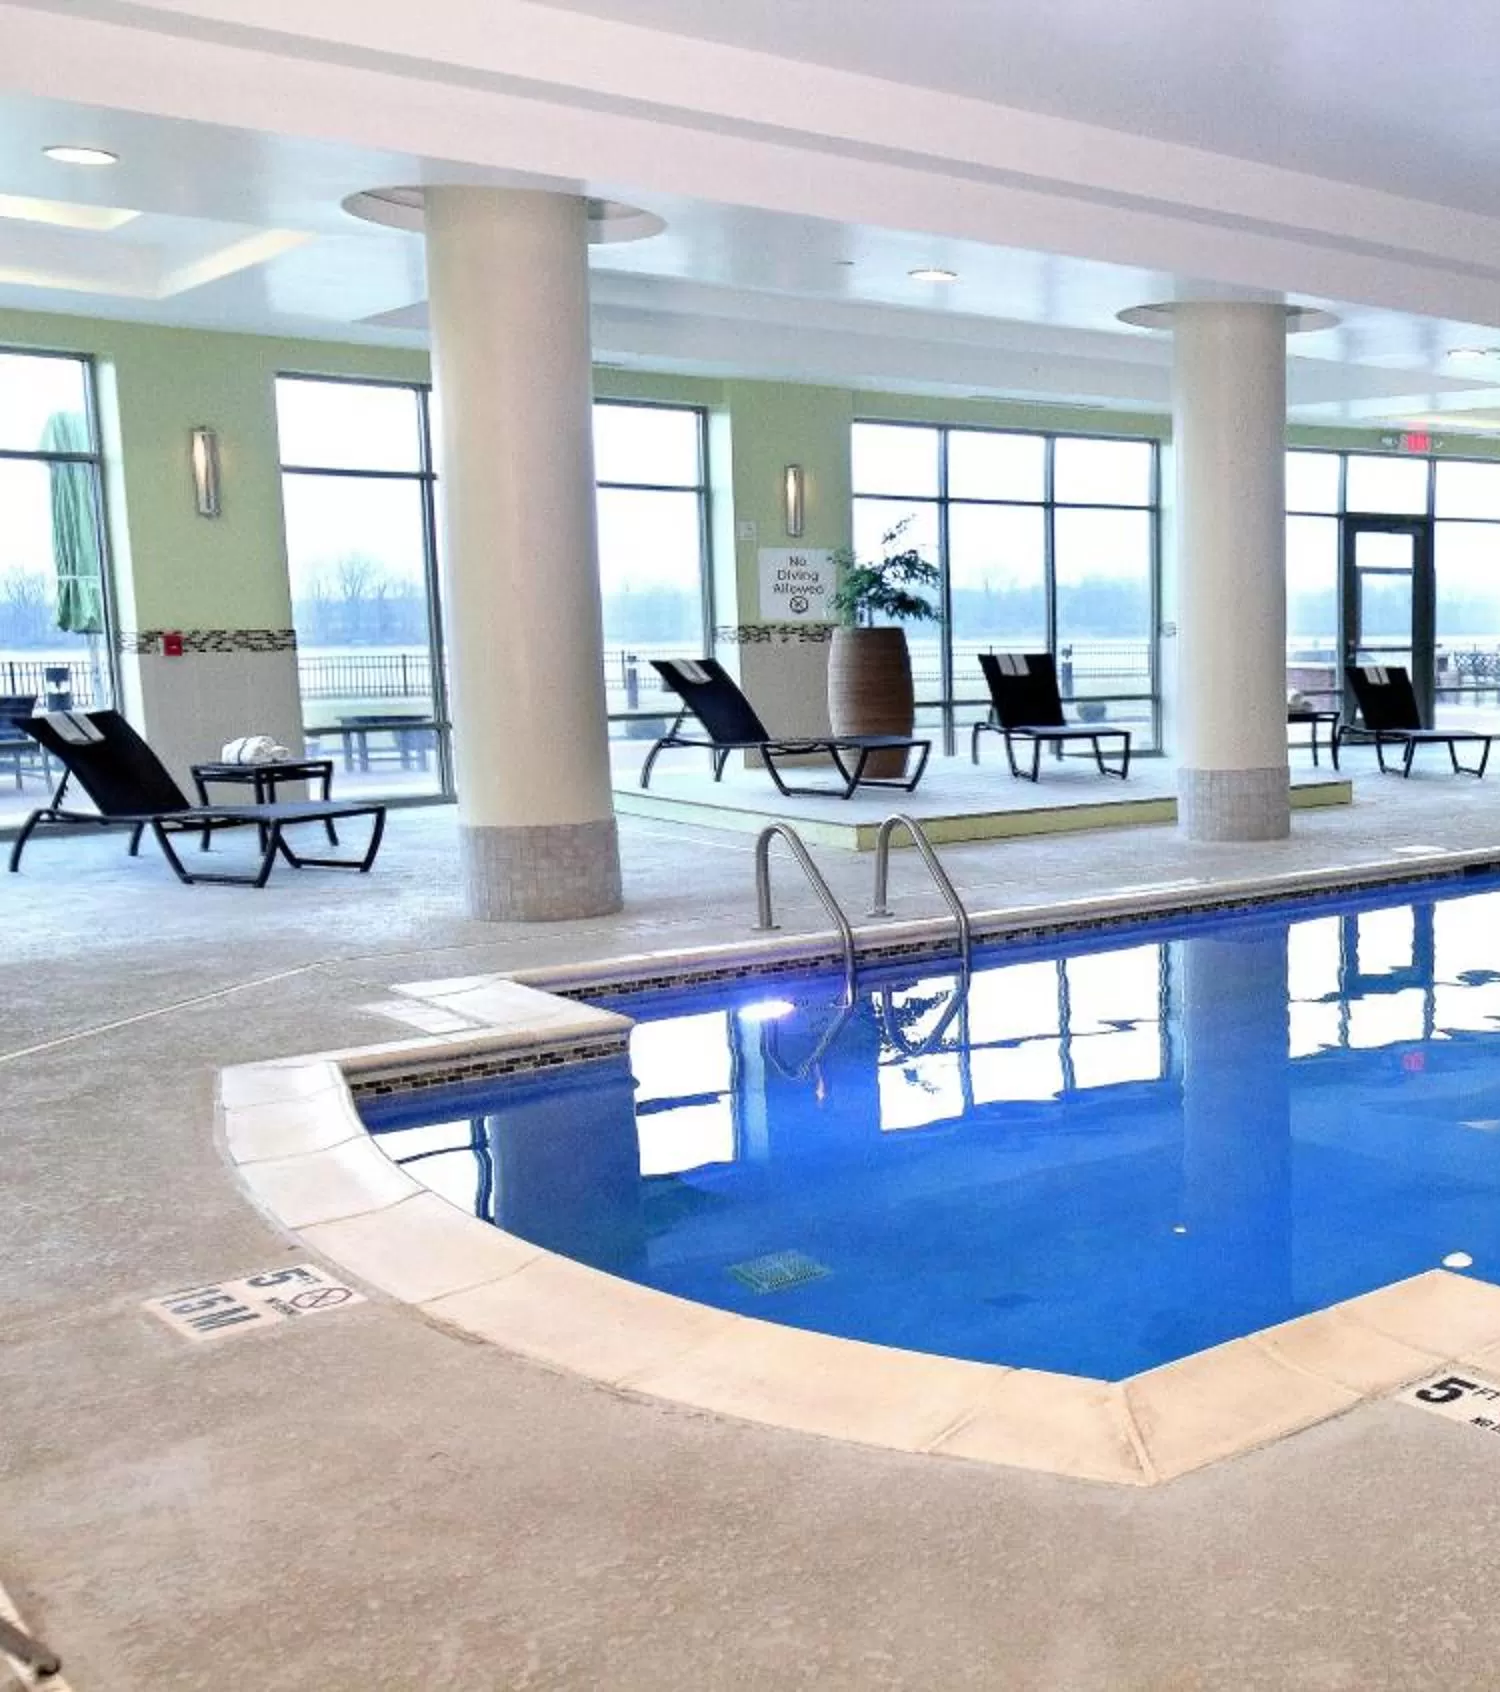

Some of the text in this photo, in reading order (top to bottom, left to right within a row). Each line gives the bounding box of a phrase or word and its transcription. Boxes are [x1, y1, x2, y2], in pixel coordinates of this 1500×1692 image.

[789, 555, 807, 566] No
[777, 569, 819, 582] Diving
[773, 583, 824, 595] Allowed
[1416, 1377, 1477, 1404] 5
[1469, 1416, 1495, 1426] NO
